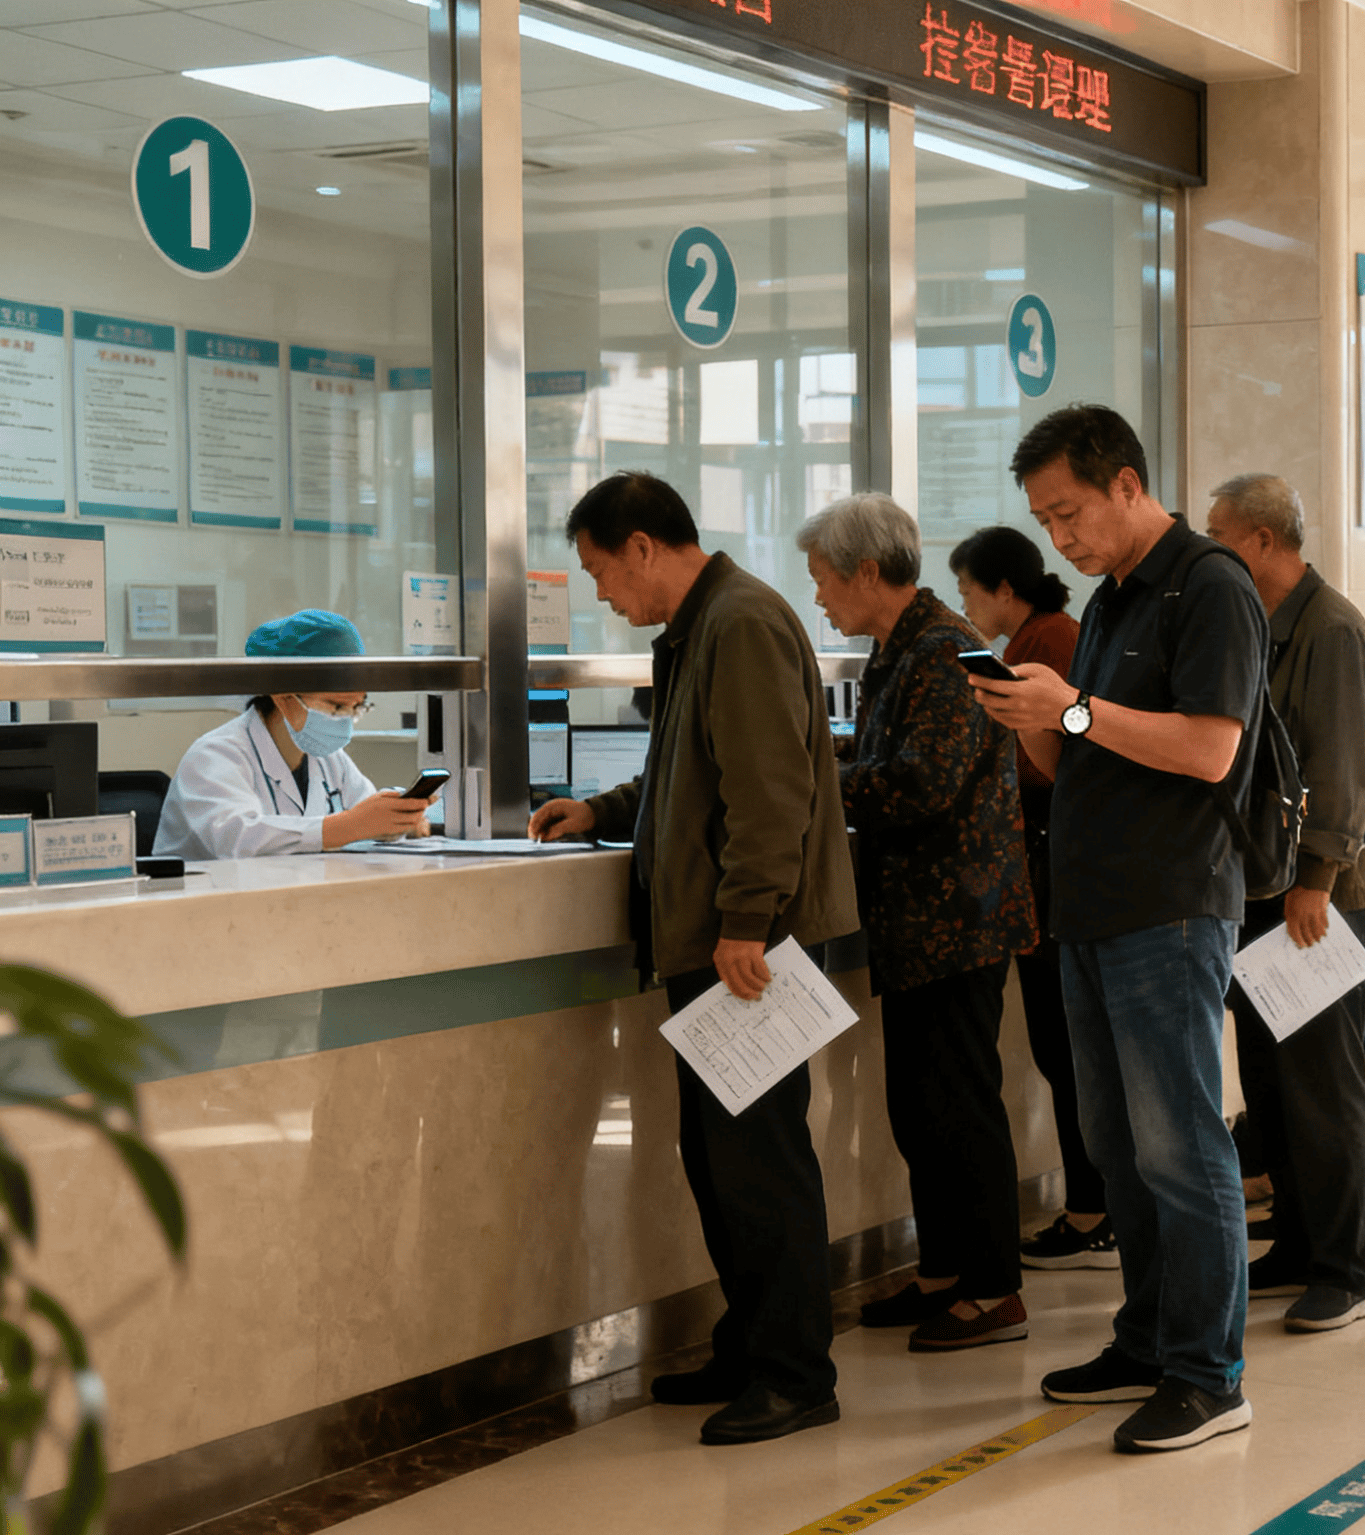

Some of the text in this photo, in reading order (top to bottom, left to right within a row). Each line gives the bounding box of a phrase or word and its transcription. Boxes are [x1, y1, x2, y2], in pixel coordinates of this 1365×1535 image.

[170, 139, 211, 250] 1
[685, 242, 719, 328] 2
[1019, 306, 1045, 379] 3
